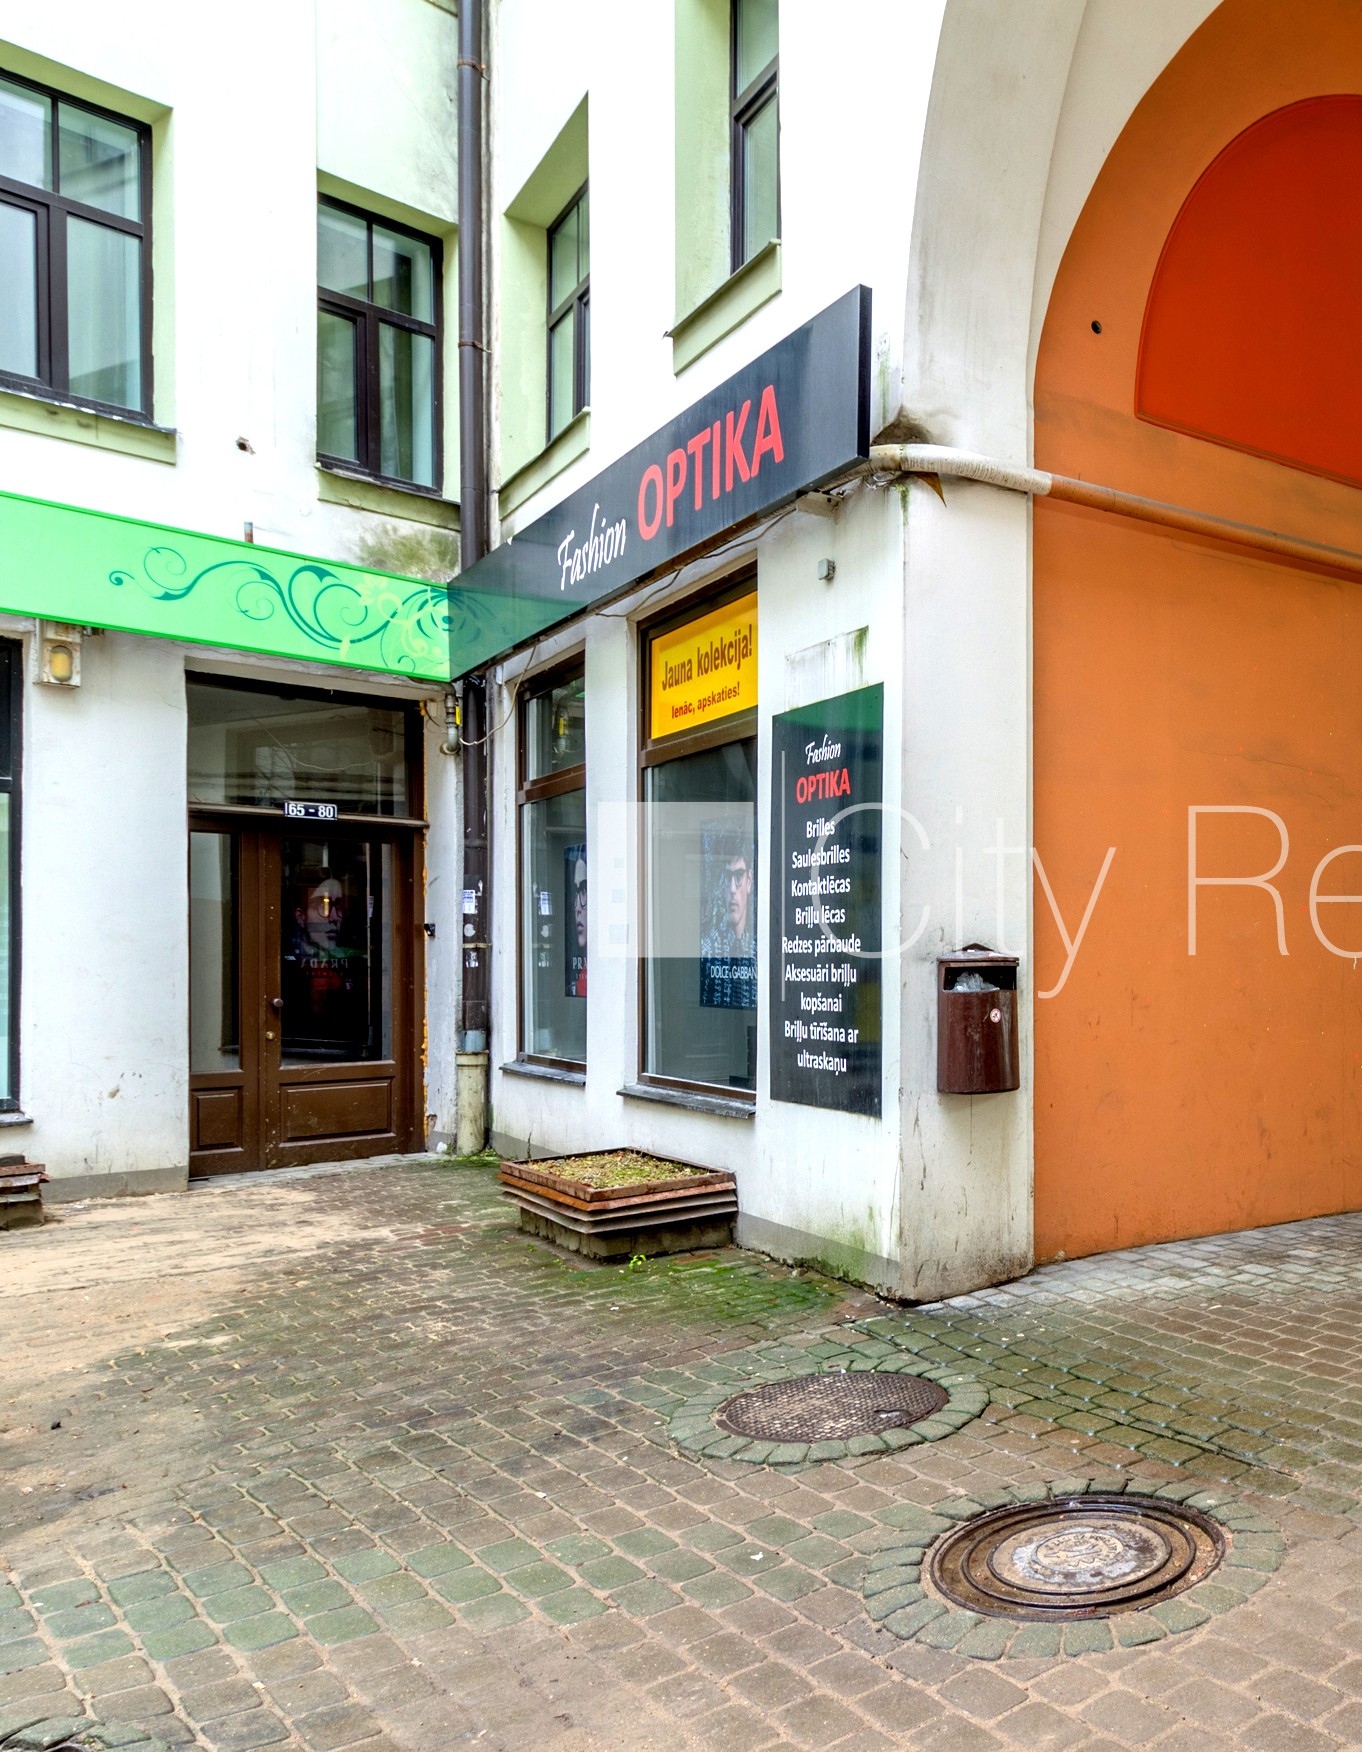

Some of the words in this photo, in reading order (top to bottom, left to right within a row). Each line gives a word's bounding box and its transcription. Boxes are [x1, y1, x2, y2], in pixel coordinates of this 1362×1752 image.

[558, 503, 626, 591] Fashion
[638, 384, 785, 541] OPTIKA
[662, 658, 693, 691] Jauna
[697, 624, 752, 670] kolekcija!
[697, 681, 740, 712] apskaties!
[805, 734, 841, 765] Fashion
[796, 768, 851, 804] OPTIKA
[288, 803, 305, 816] 65
[318, 805, 334, 818] 80
[806, 818, 836, 838] Brilles
[791, 845, 851, 869] Saulesbrilles
[791, 875, 851, 897] Kontaktlēcas
[795, 906, 819, 928] Briļļu
[821, 905, 846, 924] lēcas
[782, 936, 812, 953] Redzes
[815, 933, 861, 956] pārbaude
[785, 964, 829, 982] Aksesuāri
[831, 963, 857, 987] briļļu
[800, 992, 843, 1014] kopšanai
[784, 1020, 808, 1042] Briļļu
[809, 1021, 846, 1043] tīrīšana
[847, 1028, 859, 1044] ar
[797, 1049, 847, 1075] ultraskaņu
